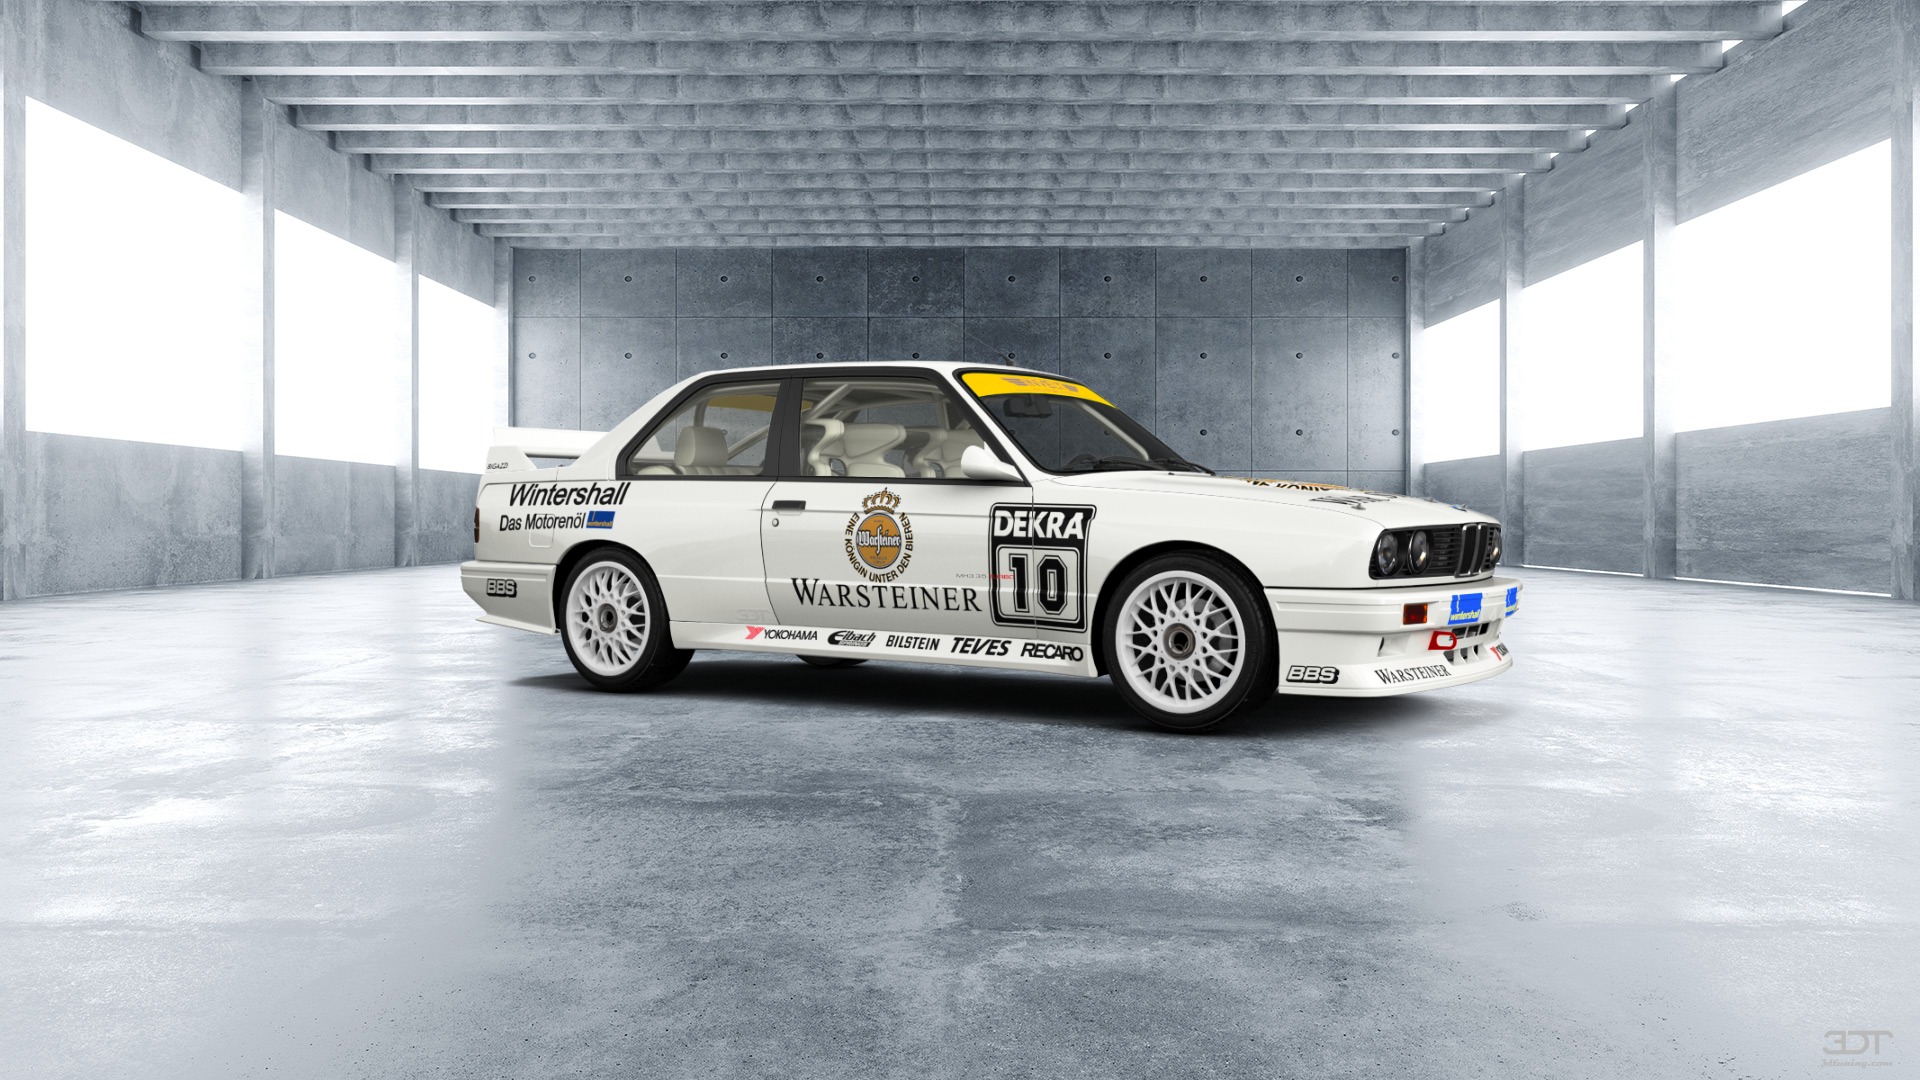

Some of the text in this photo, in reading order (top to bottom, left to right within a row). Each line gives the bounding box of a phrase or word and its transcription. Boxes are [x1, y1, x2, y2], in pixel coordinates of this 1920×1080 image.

[509, 481, 631, 507] Wintershall
[499, 512, 587, 532] Das Motorenöl
[993, 509, 1085, 540] DEKRA
[844, 511, 914, 584] EINE KÖNIGIN UNTER DEN BIEREN
[486, 578, 518, 598] BBS
[1008, 552, 1068, 616] 10
[790, 577, 983, 613] WARSTEINER
[764, 628, 818, 641] YOKOHAMA
[885, 634, 941, 651] BILSTEIN
[950, 636, 1013, 657] TEVES
[1020, 642, 1085, 663] RECARO
[1286, 664, 1341, 685] BBS
[1374, 664, 1452, 685] WARSTEINER
